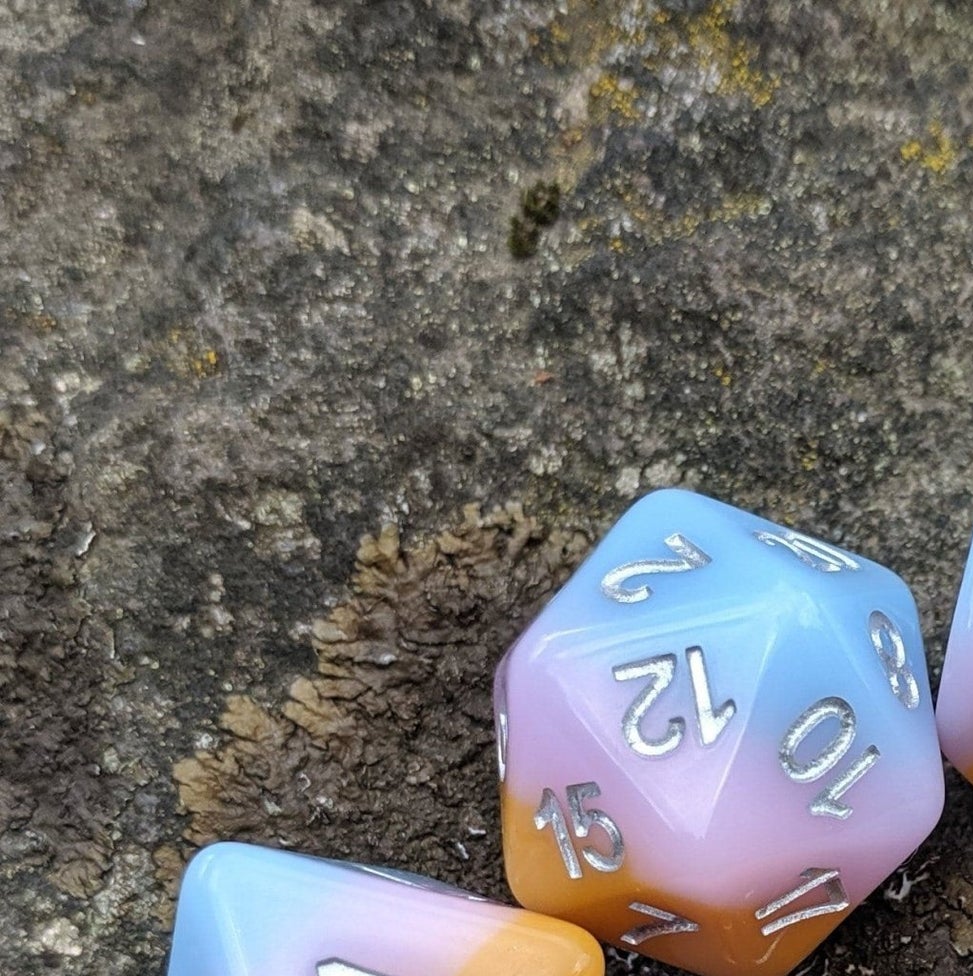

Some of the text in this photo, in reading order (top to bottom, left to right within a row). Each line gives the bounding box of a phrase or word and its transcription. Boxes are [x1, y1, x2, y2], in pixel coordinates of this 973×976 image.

[600, 532, 712, 604] 2
[612, 645, 737, 760] 12
[868, 610, 920, 709] 8
[778, 696, 881, 821] 10
[534, 781, 625, 880] 15
[620, 901, 700, 946] 7
[754, 866, 849, 937] 17
